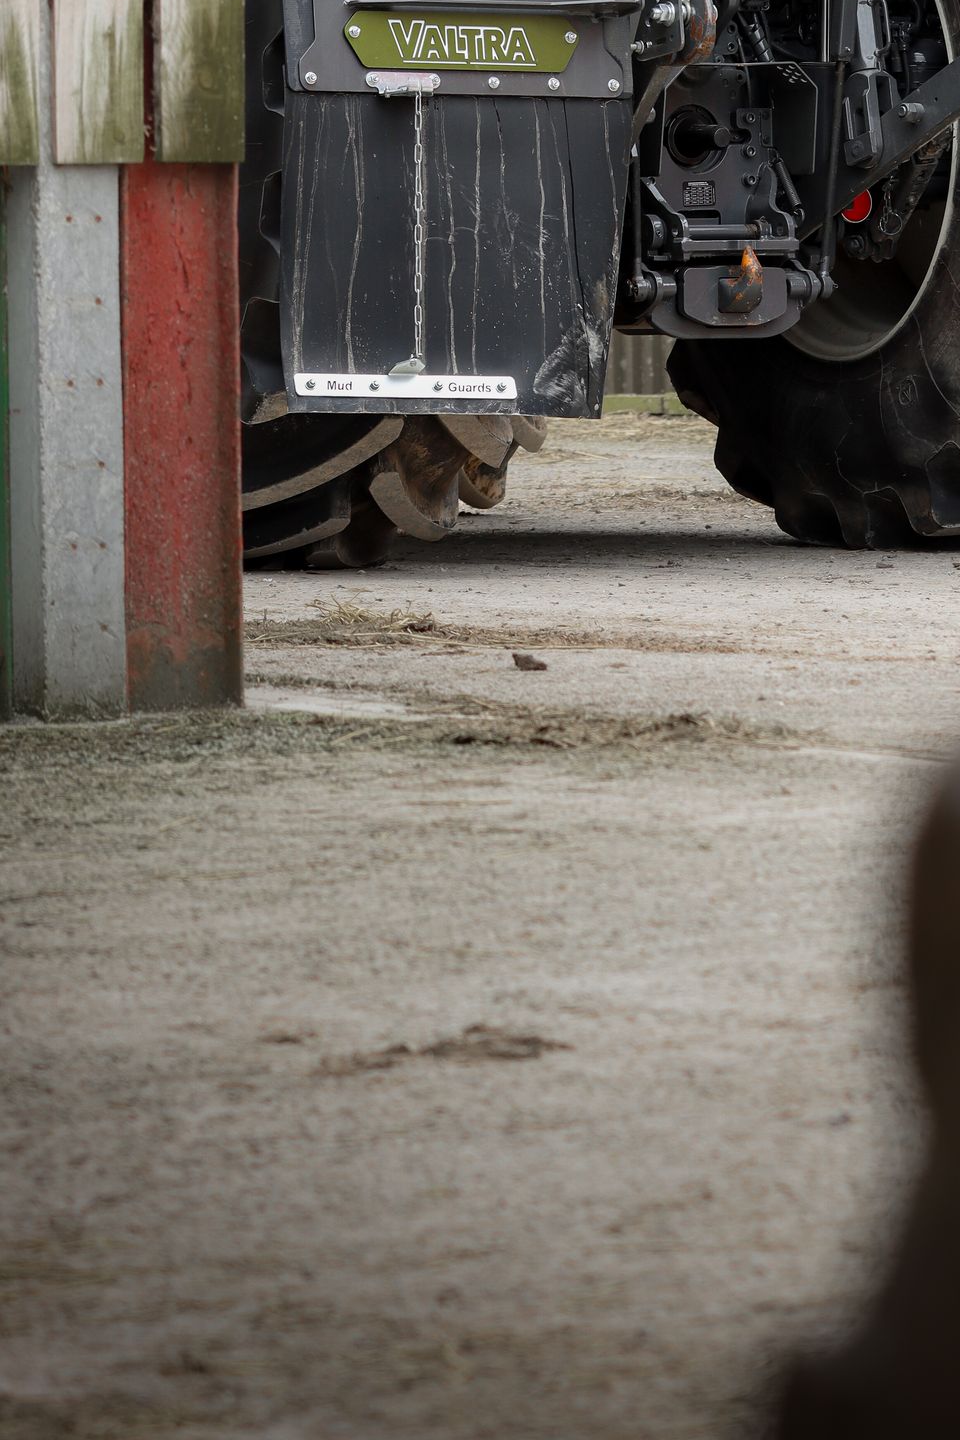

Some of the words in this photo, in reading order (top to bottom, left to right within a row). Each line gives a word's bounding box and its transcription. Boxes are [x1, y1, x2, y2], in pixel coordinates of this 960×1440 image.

[388, 19, 536, 66] VALTRA
[326, 380, 353, 392] Mud
[448, 382, 492, 394] Guards
